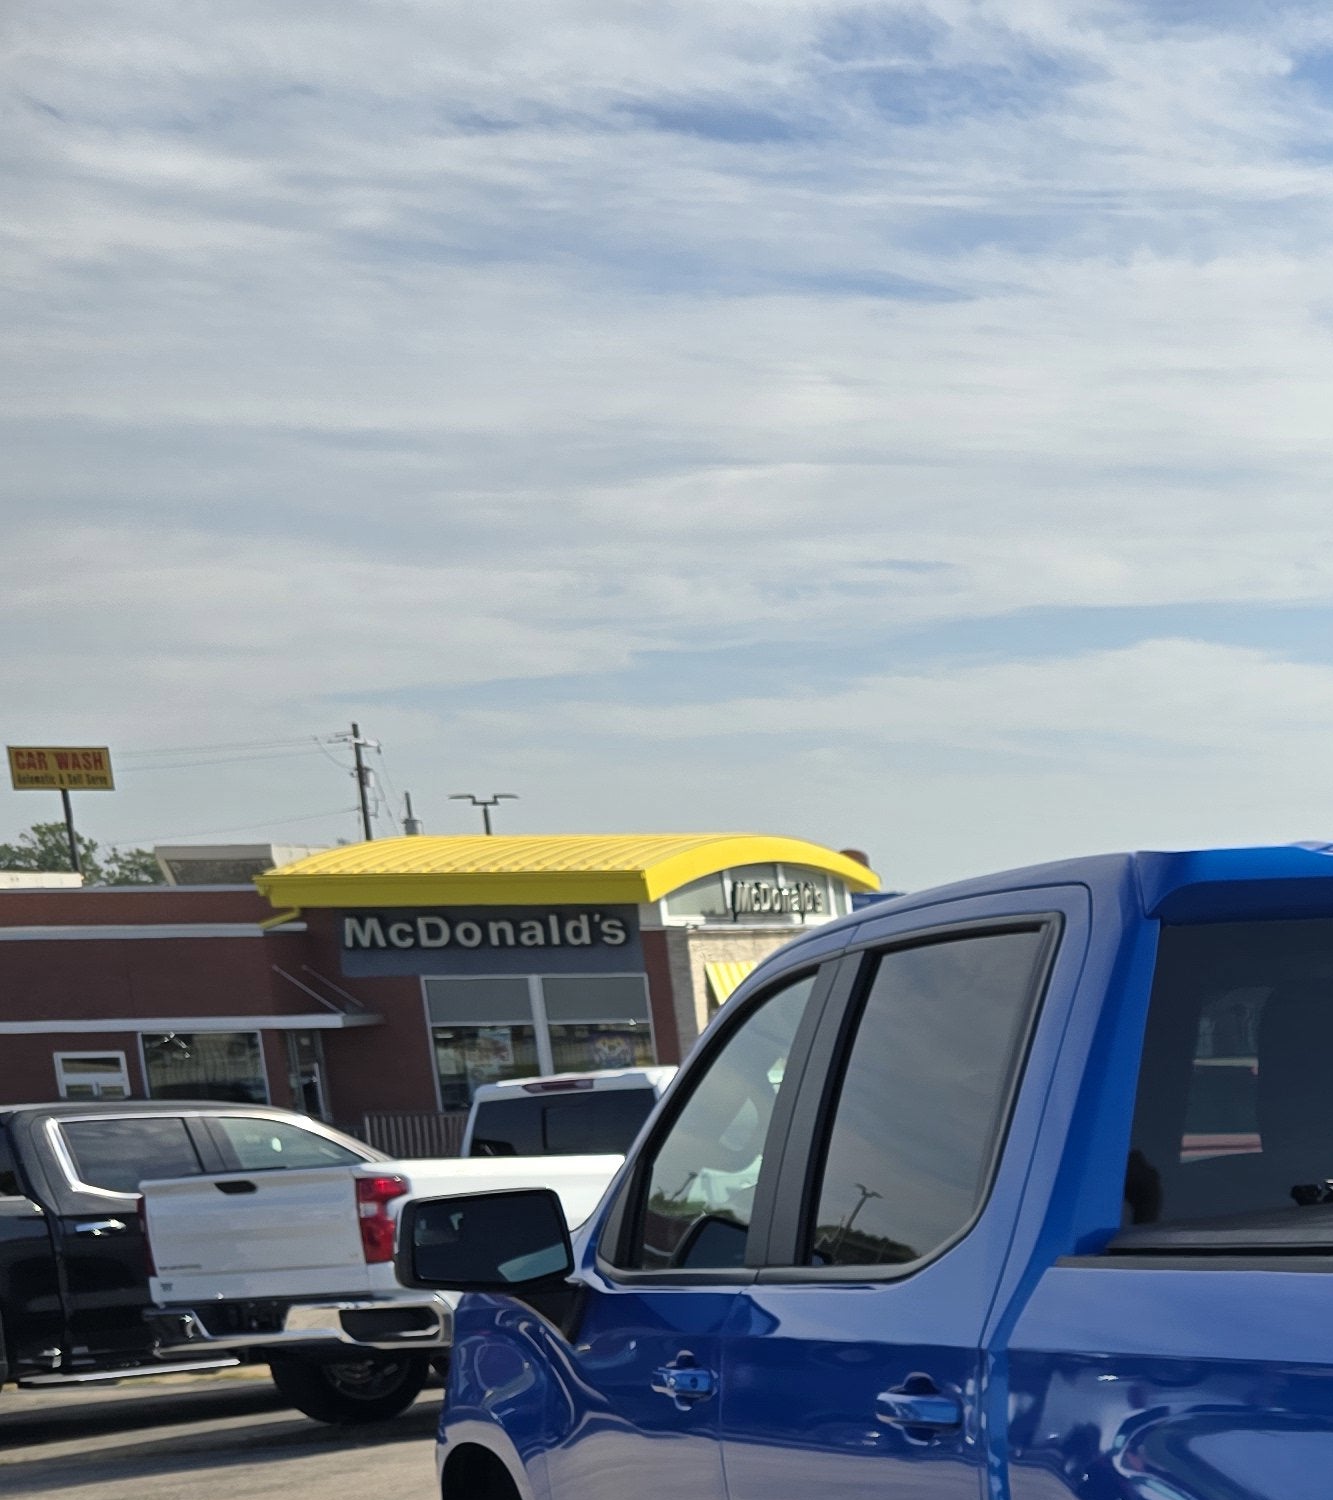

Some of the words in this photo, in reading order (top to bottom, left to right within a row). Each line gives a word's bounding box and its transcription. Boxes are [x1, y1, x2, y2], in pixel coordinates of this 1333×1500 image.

[15, 750, 49, 770] CAR
[55, 751, 104, 771] WASH
[734, 881, 824, 914] McDonald's
[343, 913, 627, 950] McDonald's
